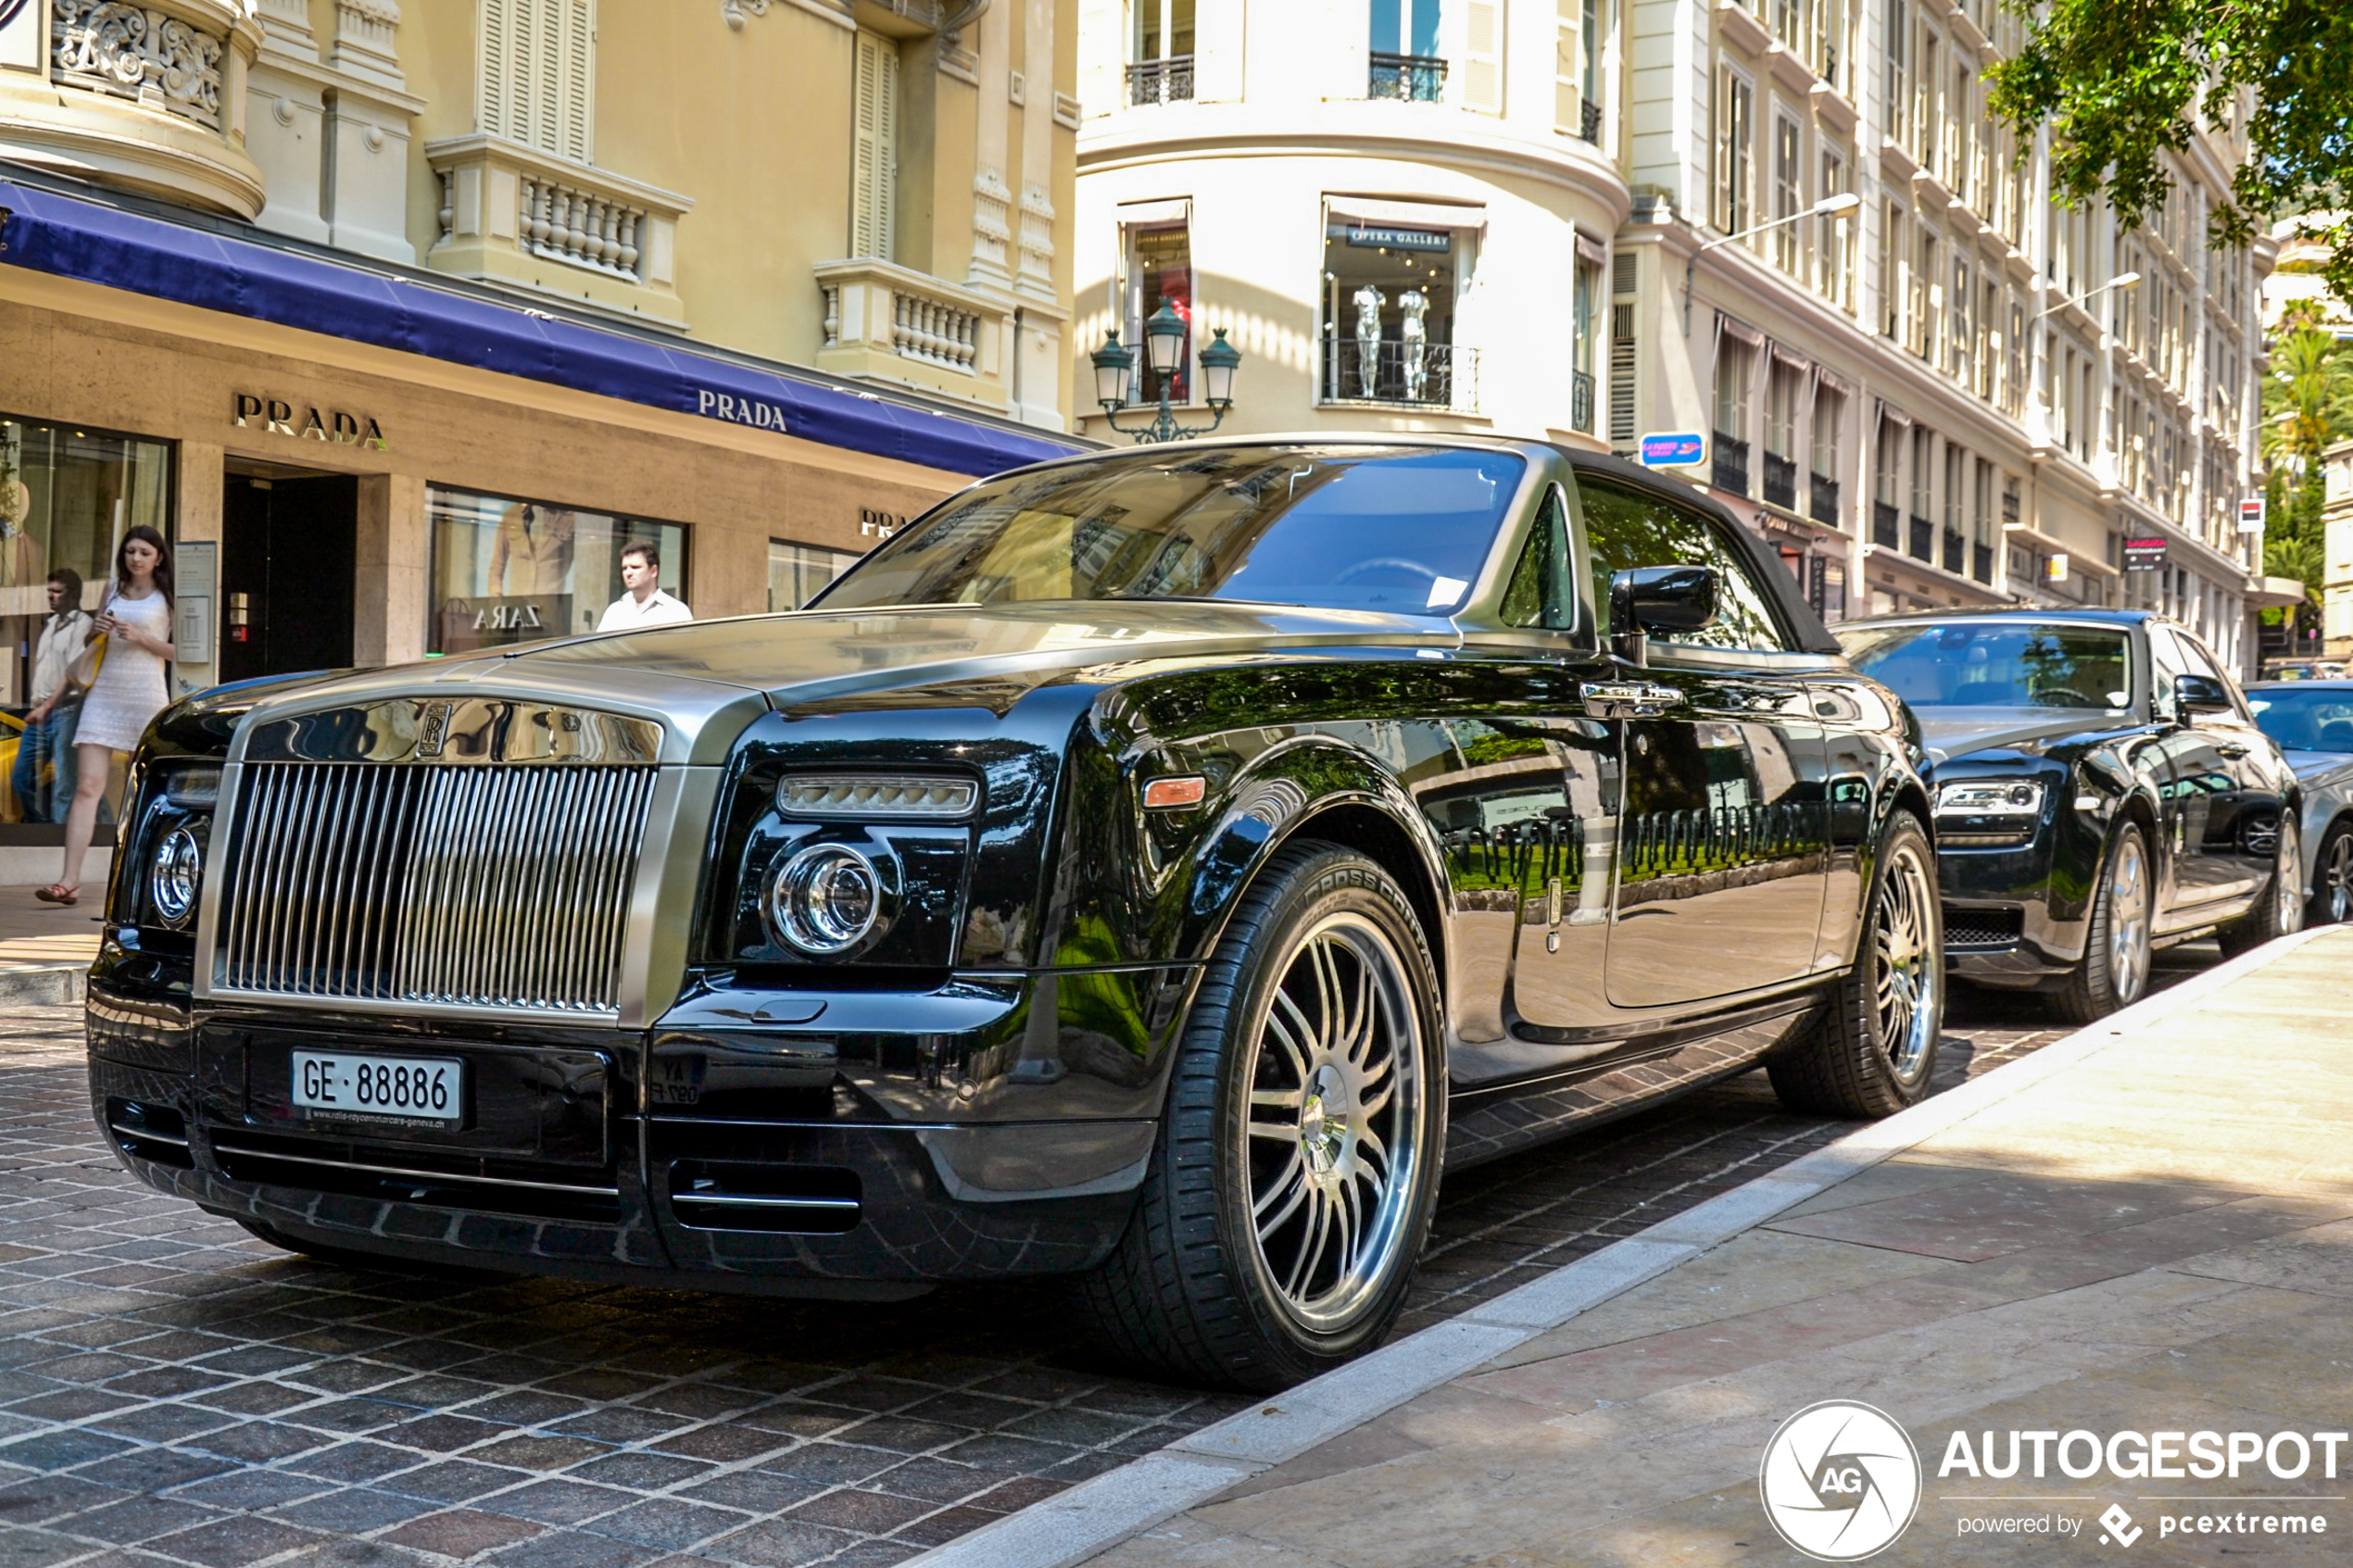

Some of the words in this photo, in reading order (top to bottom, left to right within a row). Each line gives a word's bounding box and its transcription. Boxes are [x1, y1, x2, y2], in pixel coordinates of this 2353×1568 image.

[1353, 230, 1391, 242] OPERA
[1397, 232, 1448, 245] GALLERY
[235, 393, 387, 451] PRADA
[698, 389, 787, 433] PRADA
